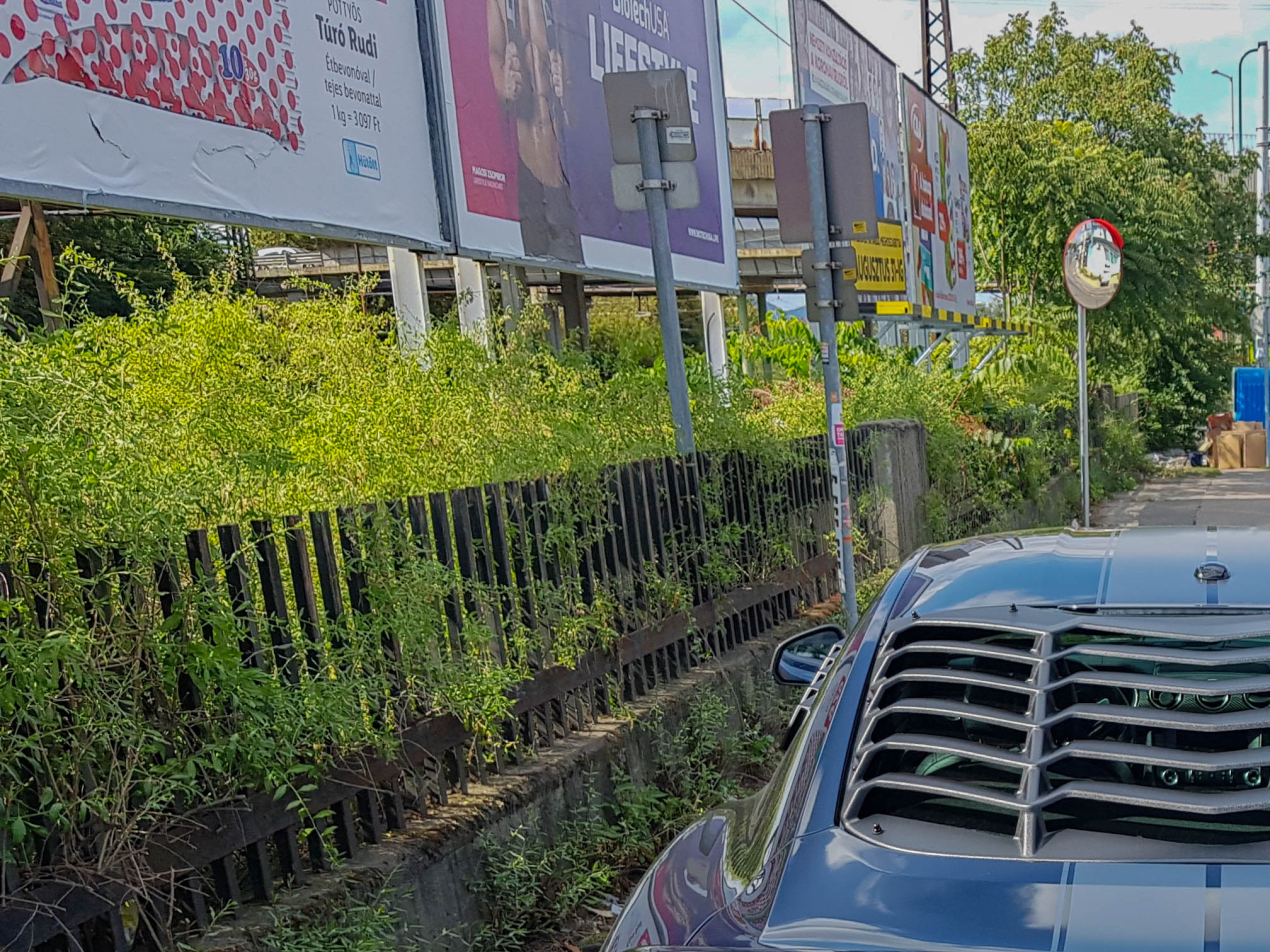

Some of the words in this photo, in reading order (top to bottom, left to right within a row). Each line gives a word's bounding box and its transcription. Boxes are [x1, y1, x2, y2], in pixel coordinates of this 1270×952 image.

[315, 14, 346, 48] Túró
[347, 25, 378, 59] Rudi
[325, 52, 371, 84] Étbevonóval
[588, 13, 699, 125] LIFEE
[325, 78, 343, 98] tejes
[343, 82, 382, 108] bevonattal
[373, 116, 382, 132] Ft
